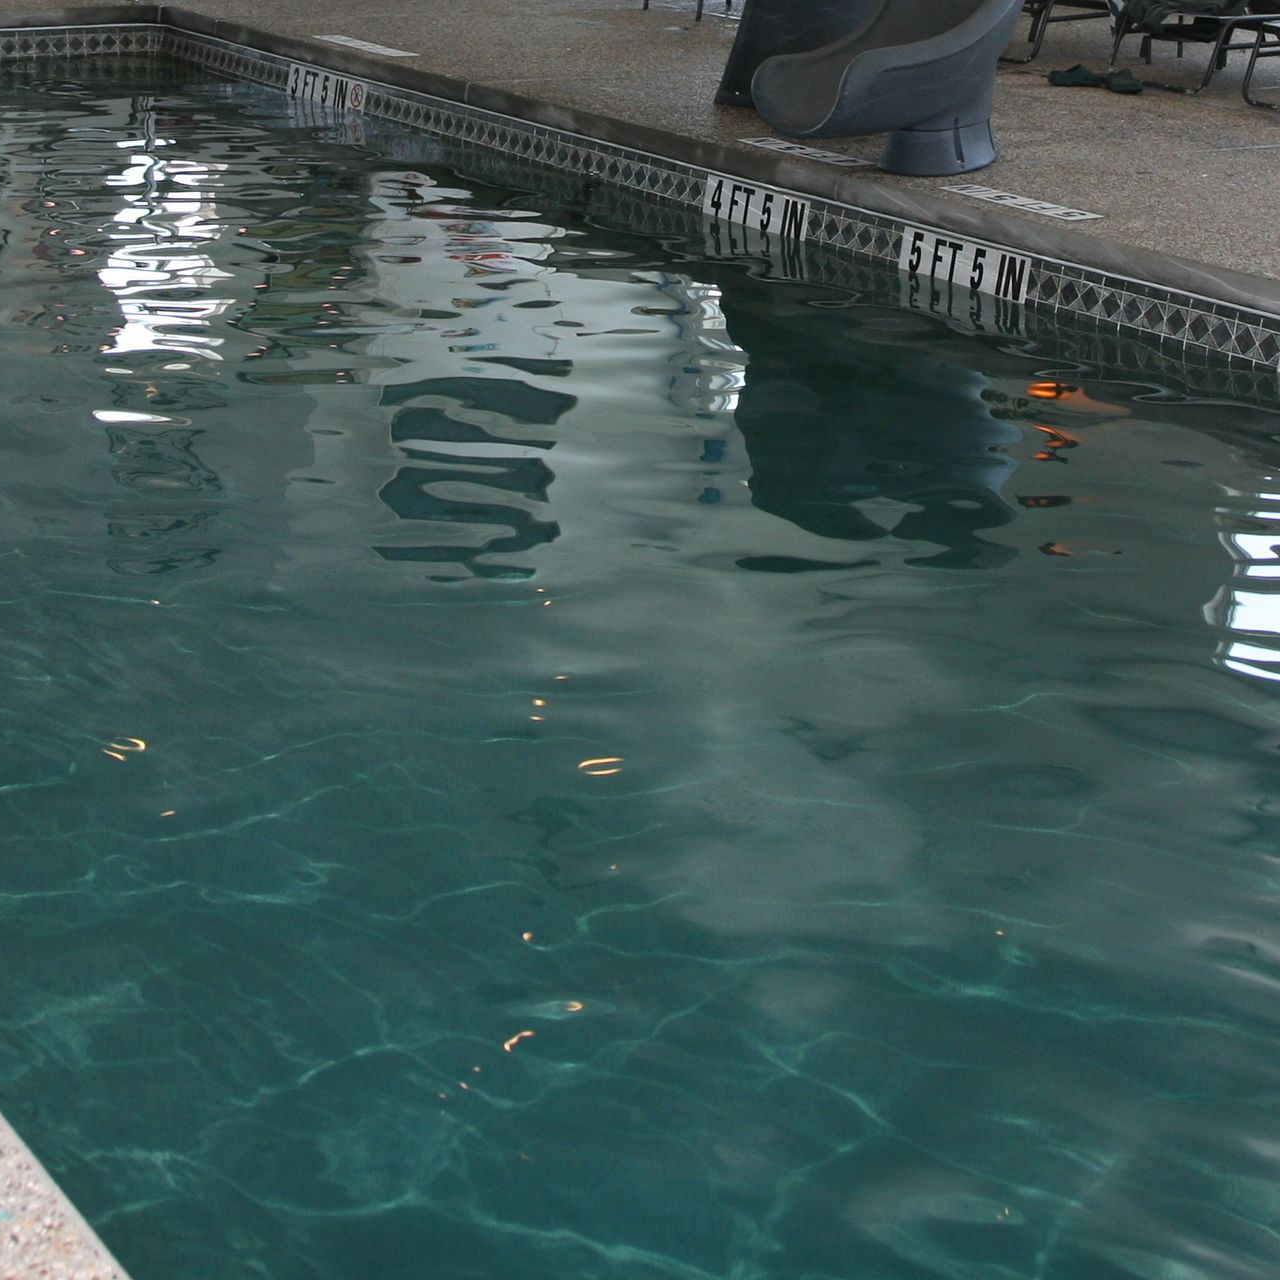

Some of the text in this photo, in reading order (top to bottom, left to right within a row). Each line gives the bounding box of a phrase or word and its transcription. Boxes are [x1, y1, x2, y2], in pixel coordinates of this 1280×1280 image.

[291, 67, 348, 110] 3 FT 5 IN
[711, 180, 806, 241] 4 FT 5 IN
[909, 231, 1026, 302] 5 FT 5 IN
